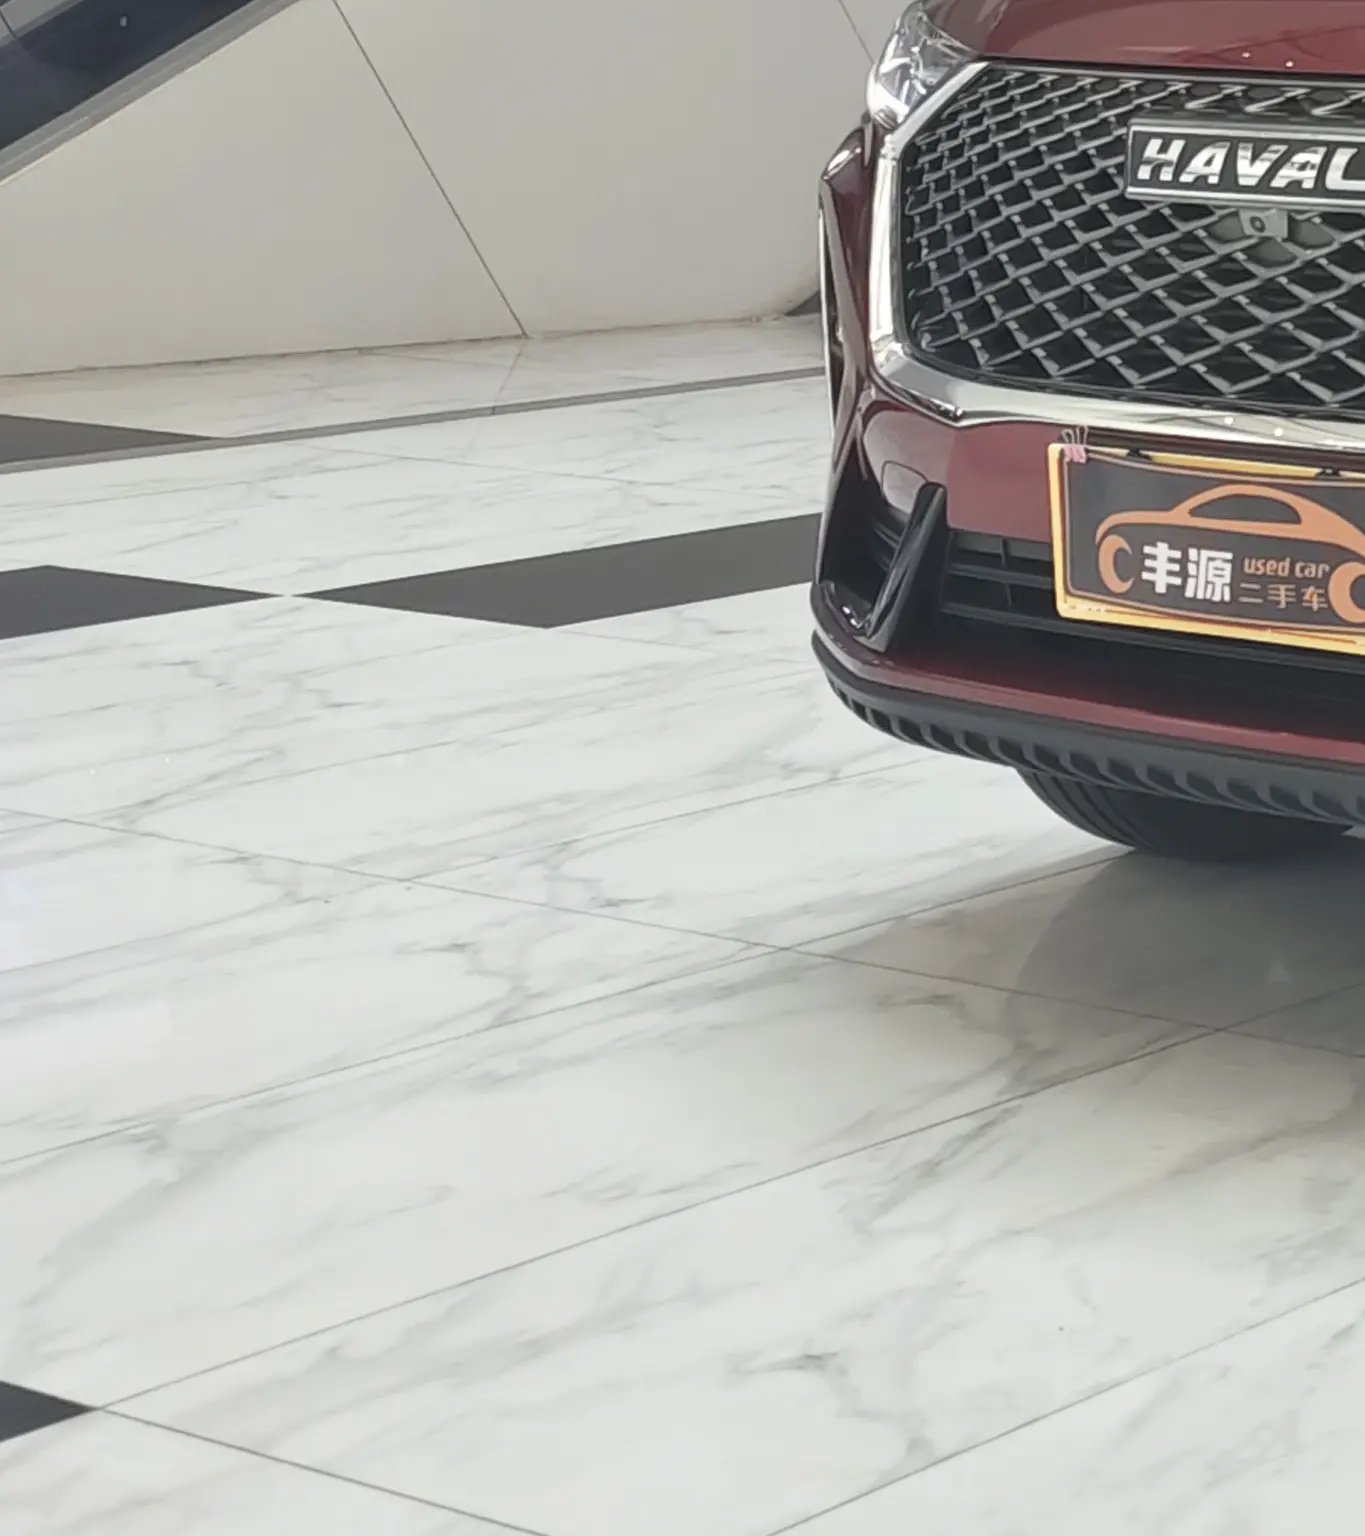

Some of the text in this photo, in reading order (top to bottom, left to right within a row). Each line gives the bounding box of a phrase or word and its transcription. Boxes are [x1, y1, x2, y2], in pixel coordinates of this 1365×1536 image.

[1141, 541, 1234, 602] 丰源
[1243, 557, 1330, 579] used car
[1238, 582, 1329, 612] 二手车
